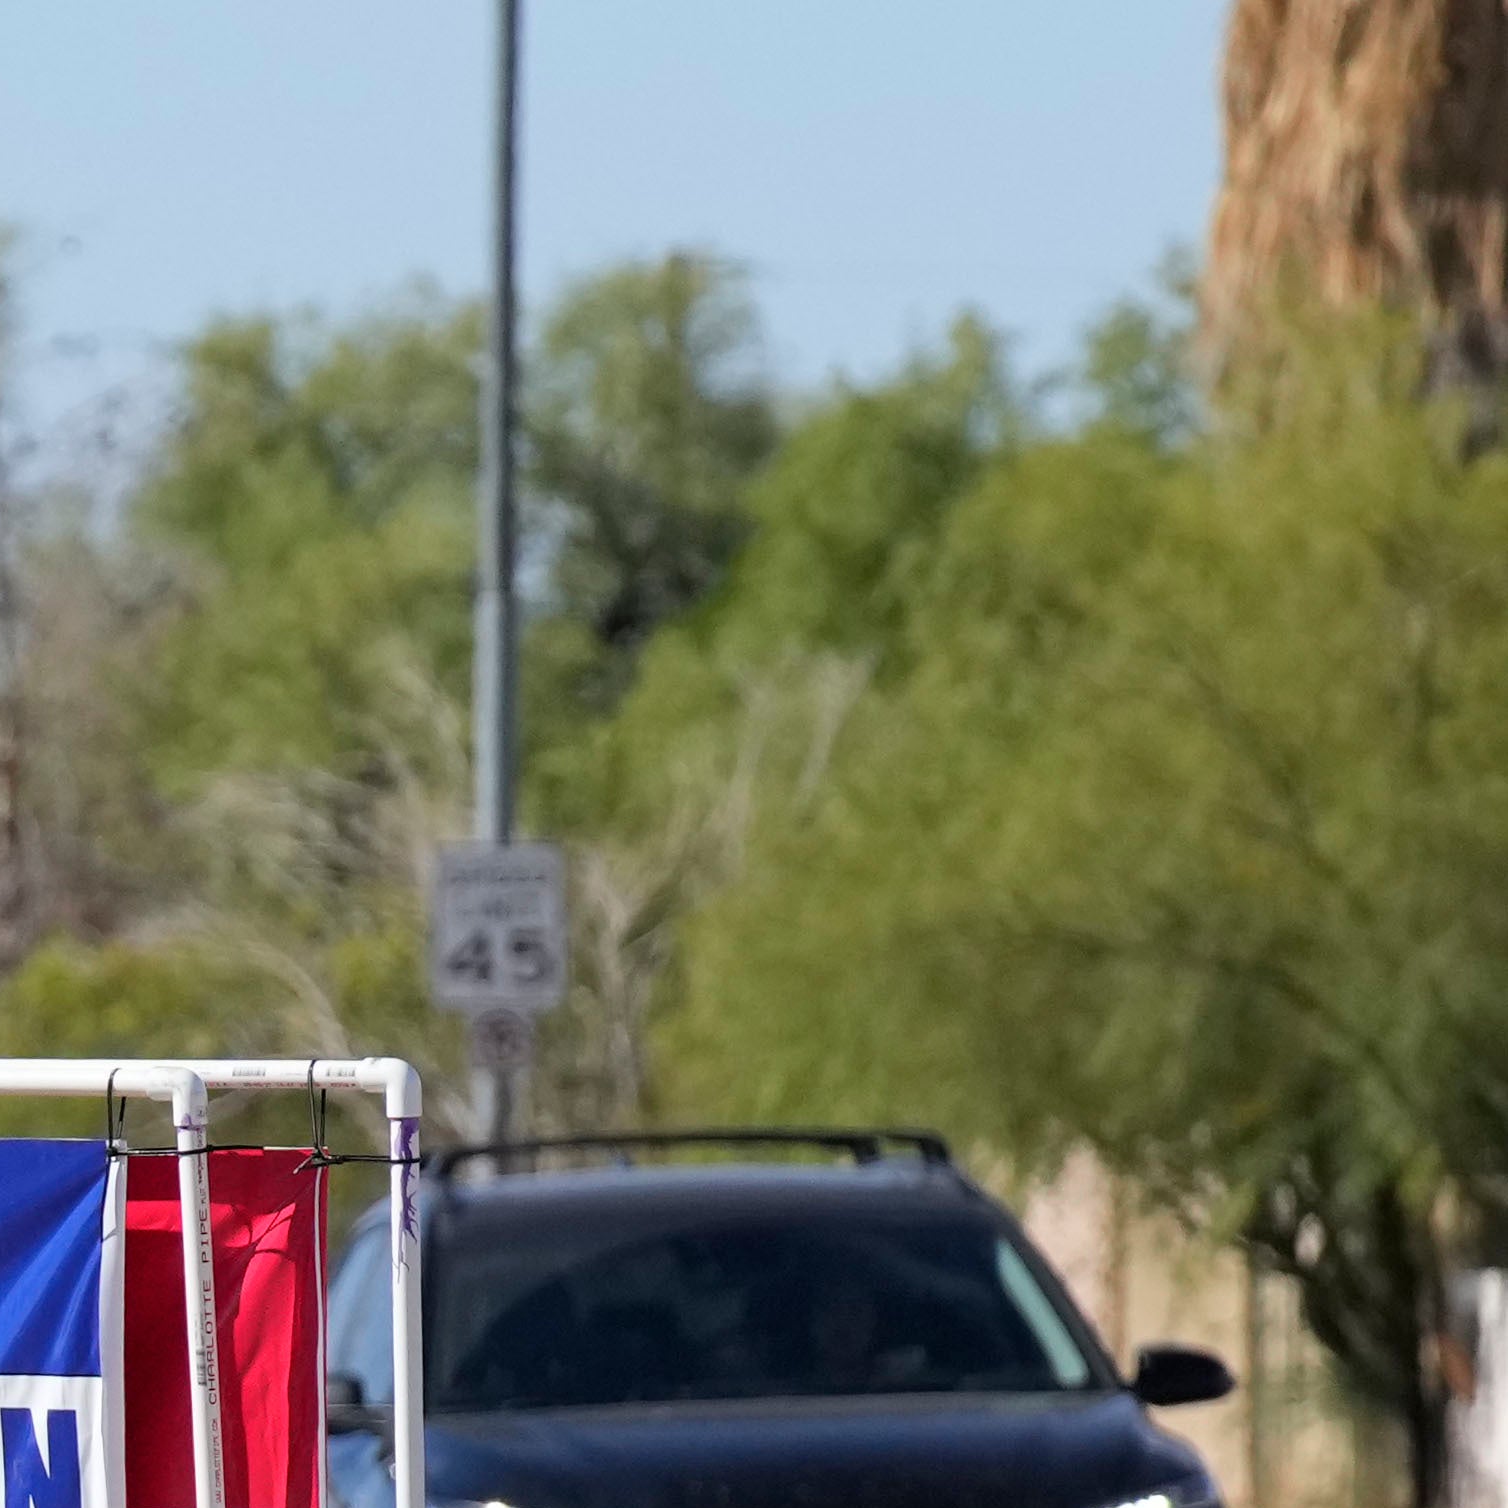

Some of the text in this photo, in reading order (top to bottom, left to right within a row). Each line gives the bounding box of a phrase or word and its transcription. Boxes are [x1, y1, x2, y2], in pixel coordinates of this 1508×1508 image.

[446, 929, 556, 986] 45
[198, 1208, 210, 1263] PIPE
[202, 1279, 217, 1405] CHARLOTTE
